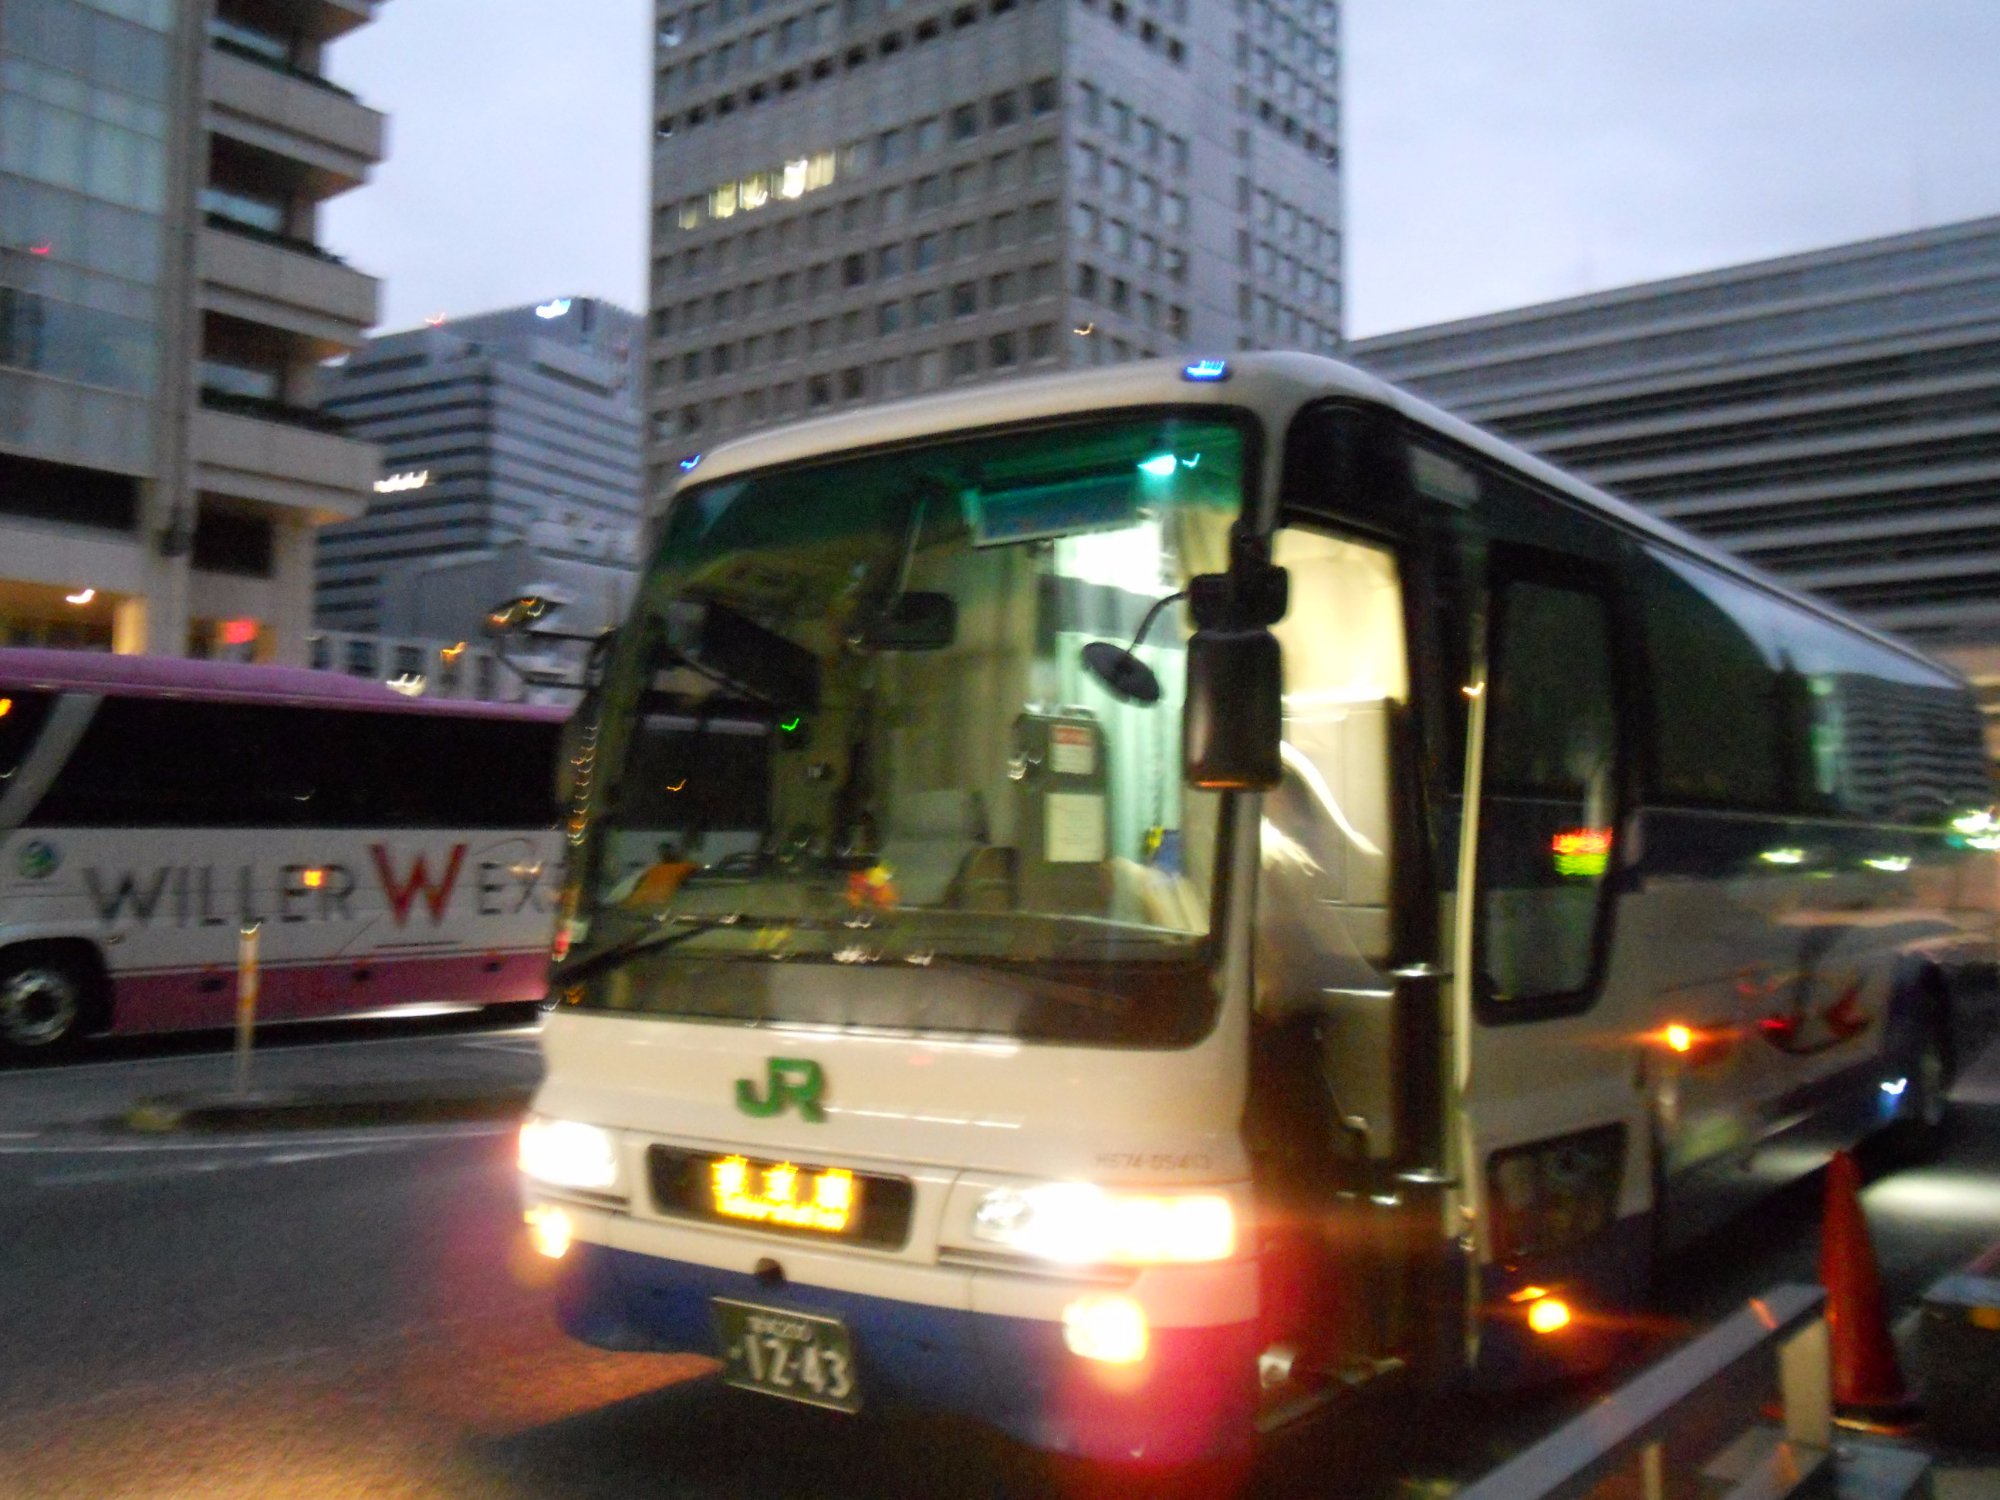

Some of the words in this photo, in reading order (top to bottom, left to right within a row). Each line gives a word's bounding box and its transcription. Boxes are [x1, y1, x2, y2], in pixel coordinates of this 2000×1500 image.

[82, 862, 355, 928] WILLER
[736, 1056, 827, 1123] JR
[745, 1333, 852, 1398] 12-43
